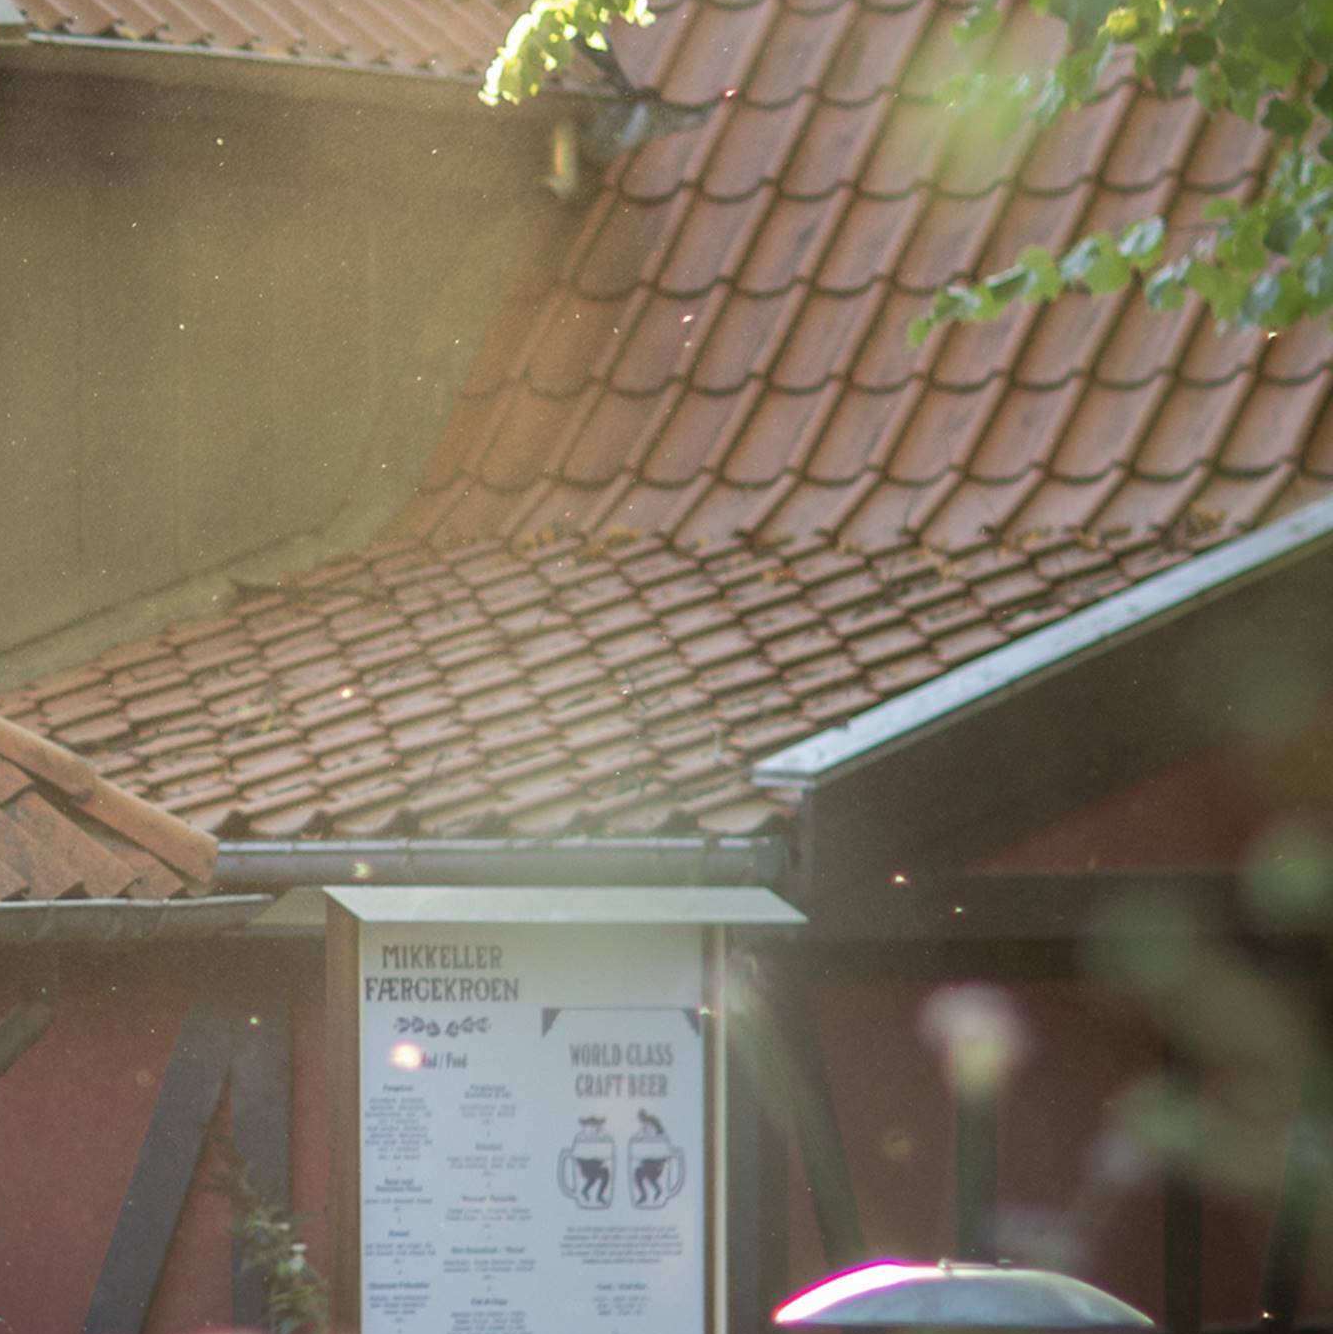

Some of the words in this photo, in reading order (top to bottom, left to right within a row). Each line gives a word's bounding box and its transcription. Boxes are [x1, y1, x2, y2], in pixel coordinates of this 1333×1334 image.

[382, 943, 503, 970] MIKKELLER
[364, 976, 520, 1003] FÆRGEKROEN
[569, 1042, 621, 1067] WORLD
[626, 1042, 674, 1068] CLASS
[575, 1072, 624, 1098] CRAFT
[627, 1072, 668, 1098] BEER
